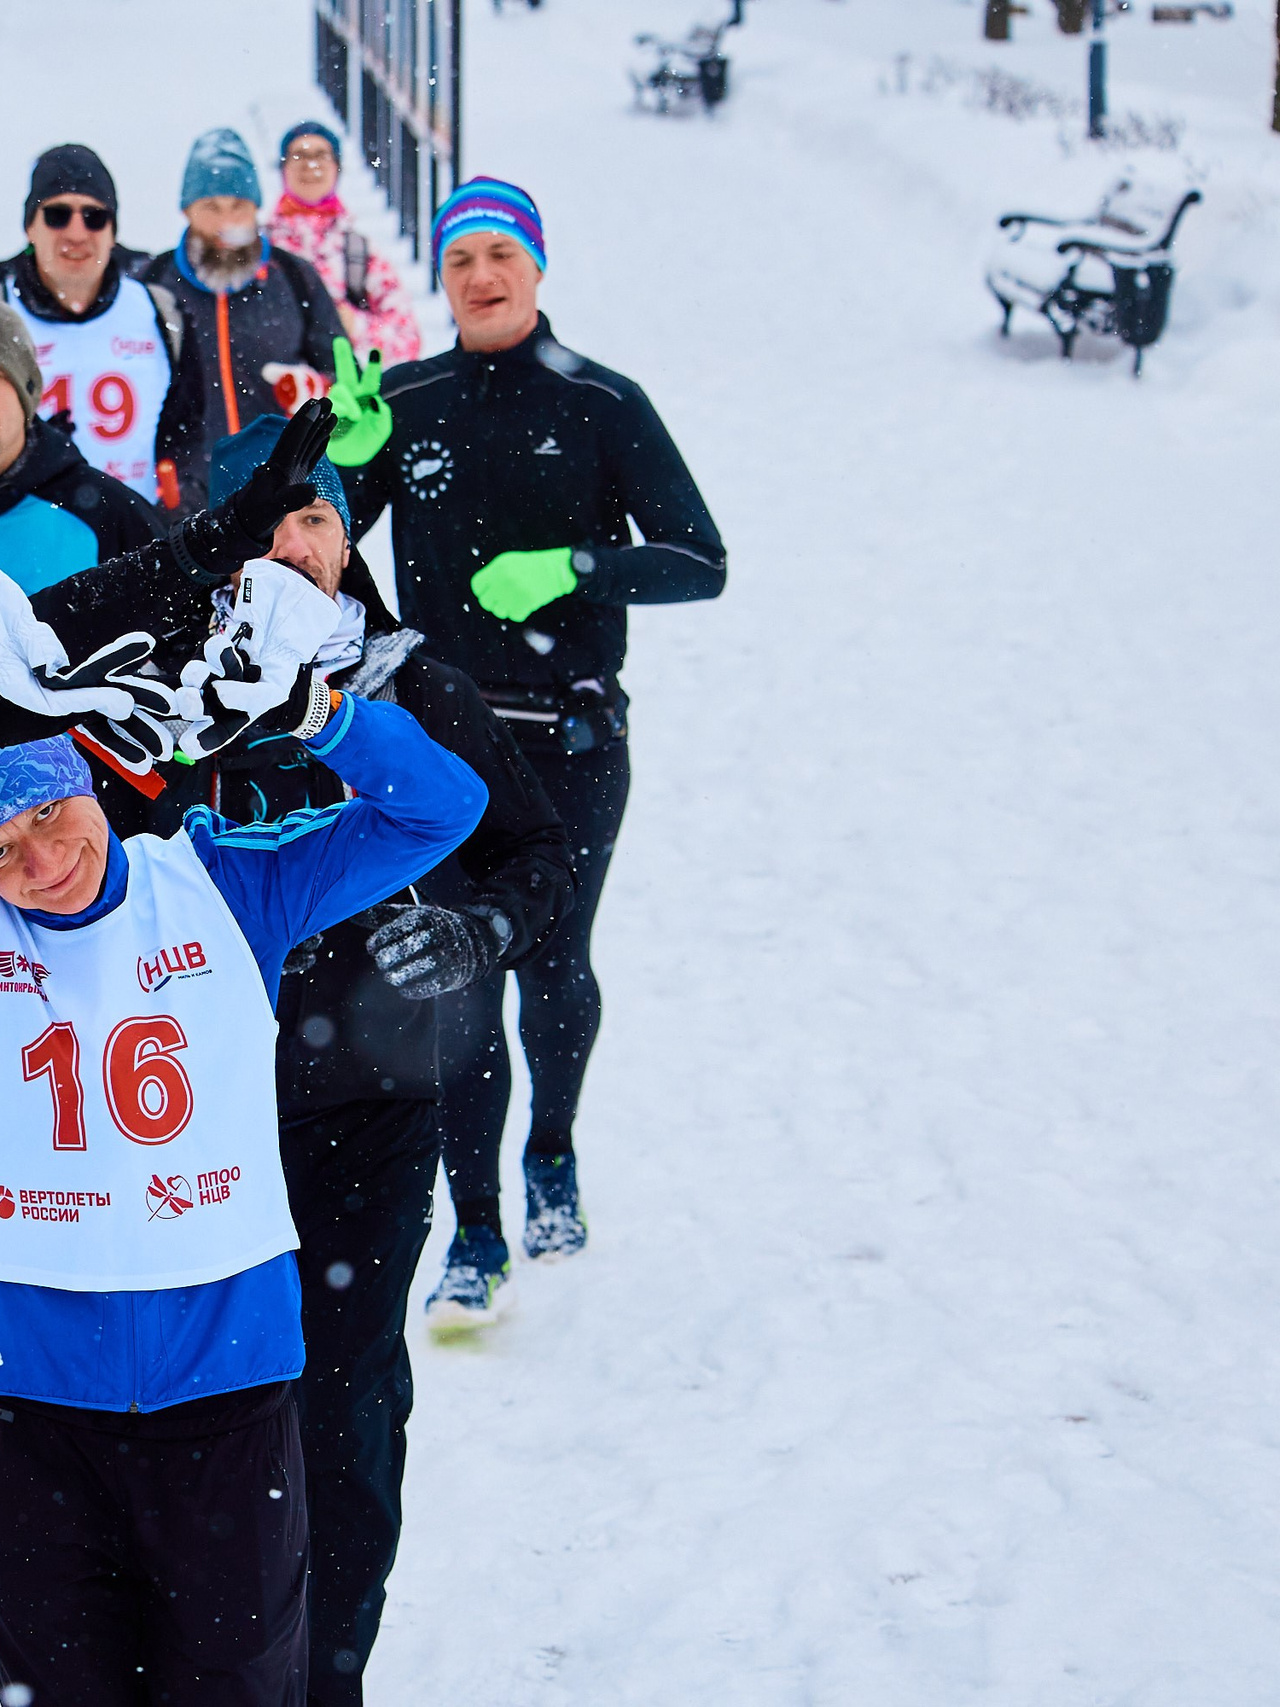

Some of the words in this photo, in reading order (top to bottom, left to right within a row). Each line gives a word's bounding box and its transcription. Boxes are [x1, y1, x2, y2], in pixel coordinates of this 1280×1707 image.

[41, 372, 137, 444] 19
[143, 941, 207, 985] НЦВ
[20, 1014, 194, 1152] 16
[197, 1165, 241, 1190] ППОО
[19, 1189, 111, 1207] ВЕРТОЛЕТЫ
[199, 1185, 231, 1206] НЦВ
[21, 1206, 80, 1223] РОССИИ
